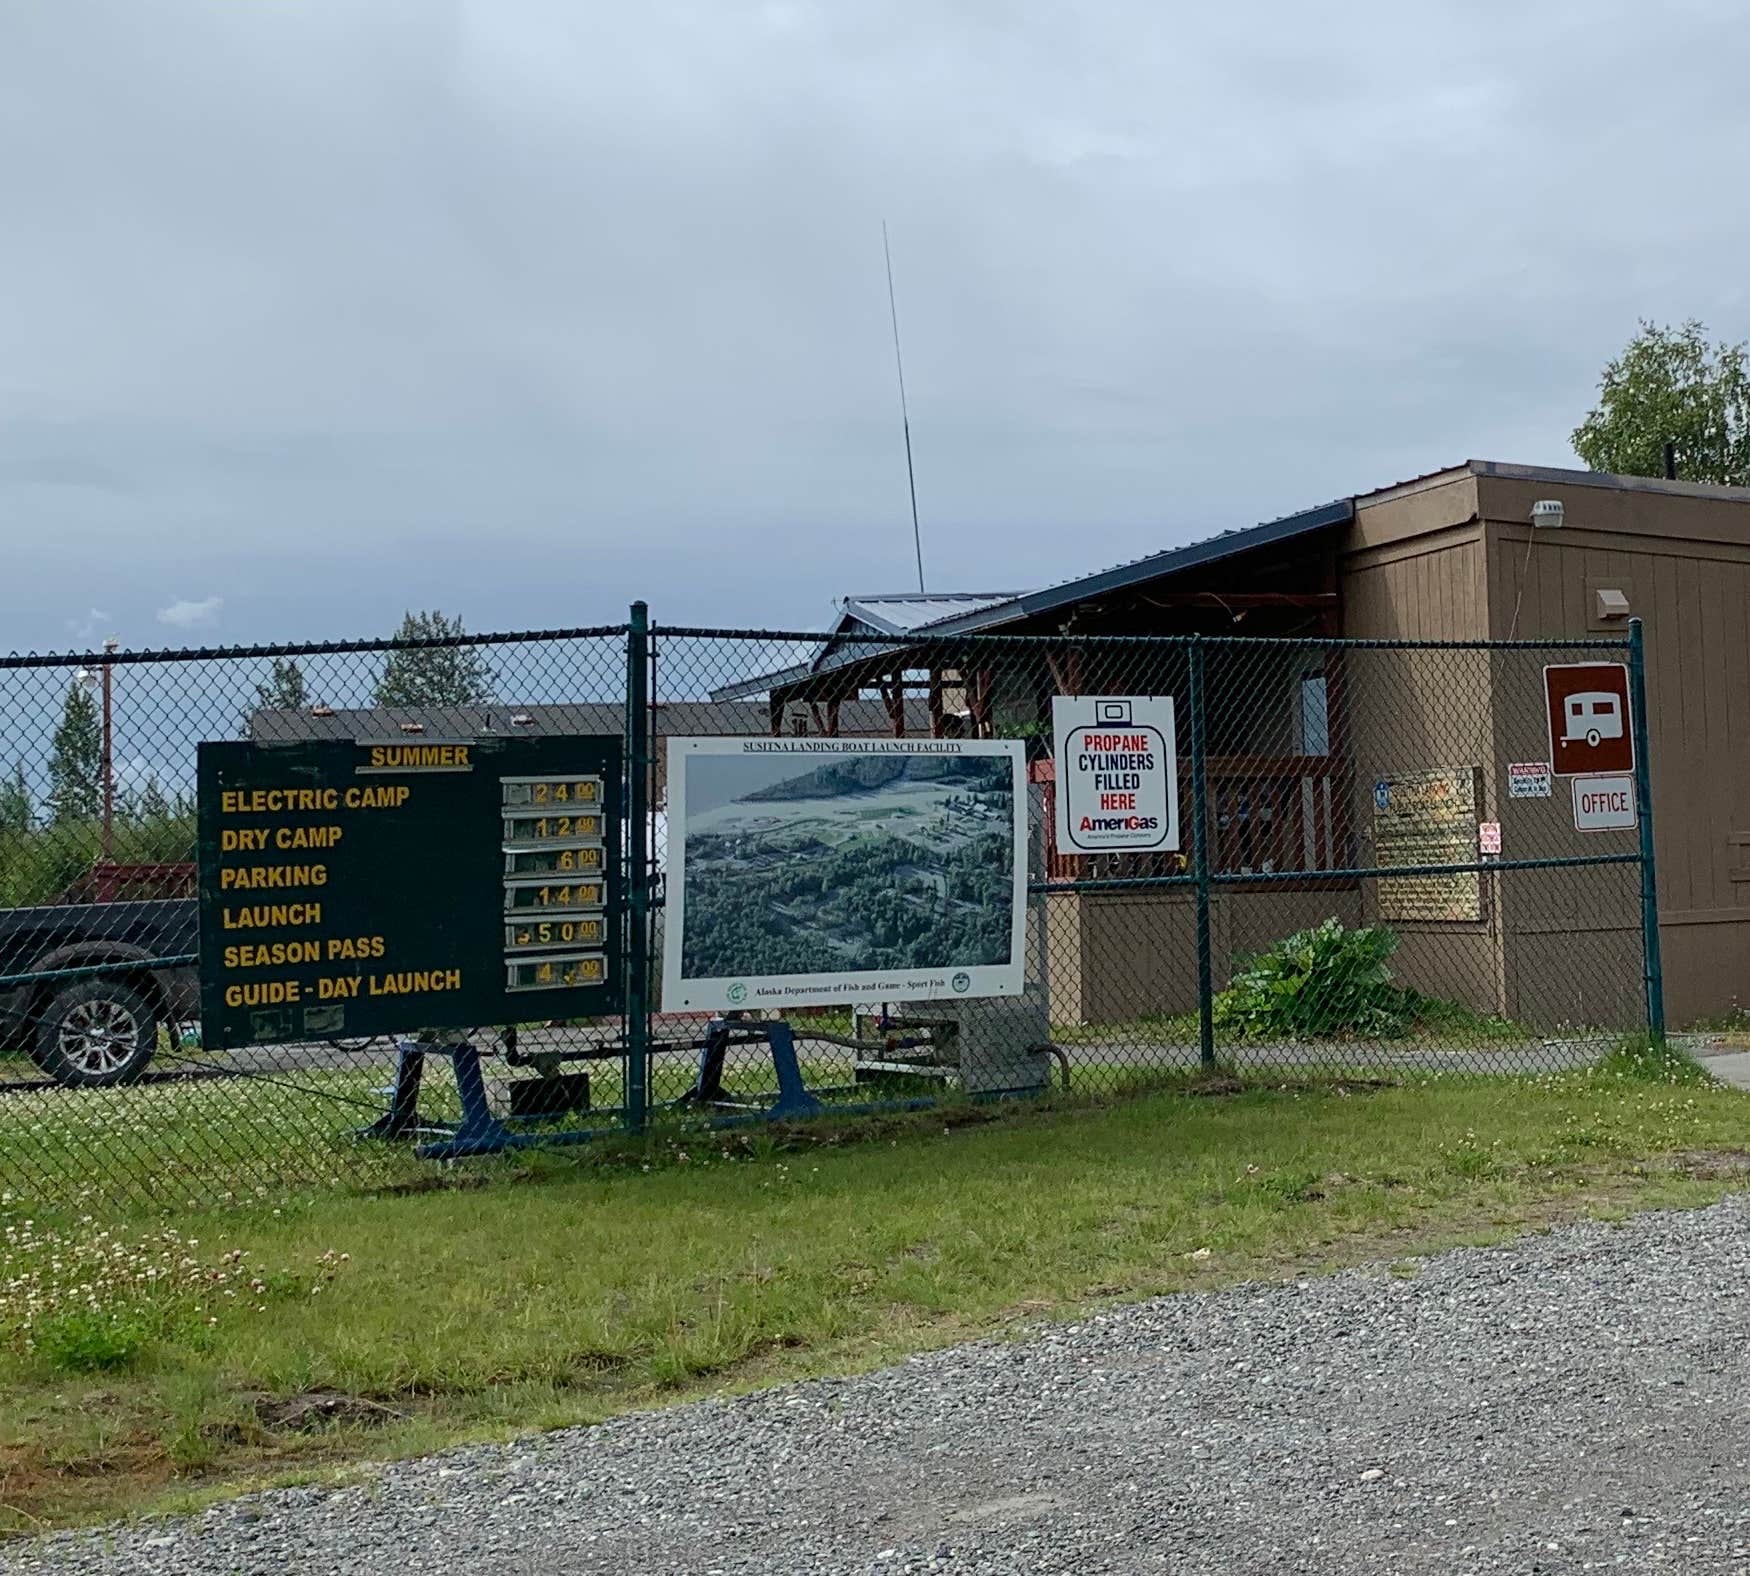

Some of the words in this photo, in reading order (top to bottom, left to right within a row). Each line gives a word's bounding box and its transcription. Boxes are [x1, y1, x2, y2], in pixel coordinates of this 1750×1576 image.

[743, 742, 789, 752] SUSITNA
[791, 742, 840, 752] LANDING
[842, 742, 871, 752] BOAT
[872, 743, 915, 753] LAUNCH
[917, 743, 961, 753] FACILITY
[1084, 735, 1148, 751] PROPANE
[371, 746, 469, 767] SUMMER
[1079, 754, 1154, 771] CYLINDERS
[1095, 774, 1140, 790] FILLED
[222, 788, 338, 812] ELECTRIC
[345, 786, 410, 808] CAMP
[1101, 794, 1136, 810] HERE
[1582, 792, 1629, 814] OFFICE
[1080, 816, 1158, 831] AmeriGas
[222, 829, 270, 850] DRY
[276, 826, 342, 849] CAMP
[221, 864, 328, 889] PARKING
[223, 903, 321, 929] LAUNCH
[224, 941, 320, 968] SEASON
[328, 936, 385, 960] PASS
[225, 980, 300, 1007] GUIDE
[319, 975, 362, 999] DAY
[369, 969, 461, 995] LAUNCH
[755, 988, 782, 996] Alaska
[784, 986, 832, 996] Department
[833, 984, 842, 992] of
[843, 983, 859, 992] Fish
[861, 982, 877, 991] and
[878, 981, 901, 990] Game
[907, 979, 929, 990] Sport
[930, 978, 945, 988] Fish
